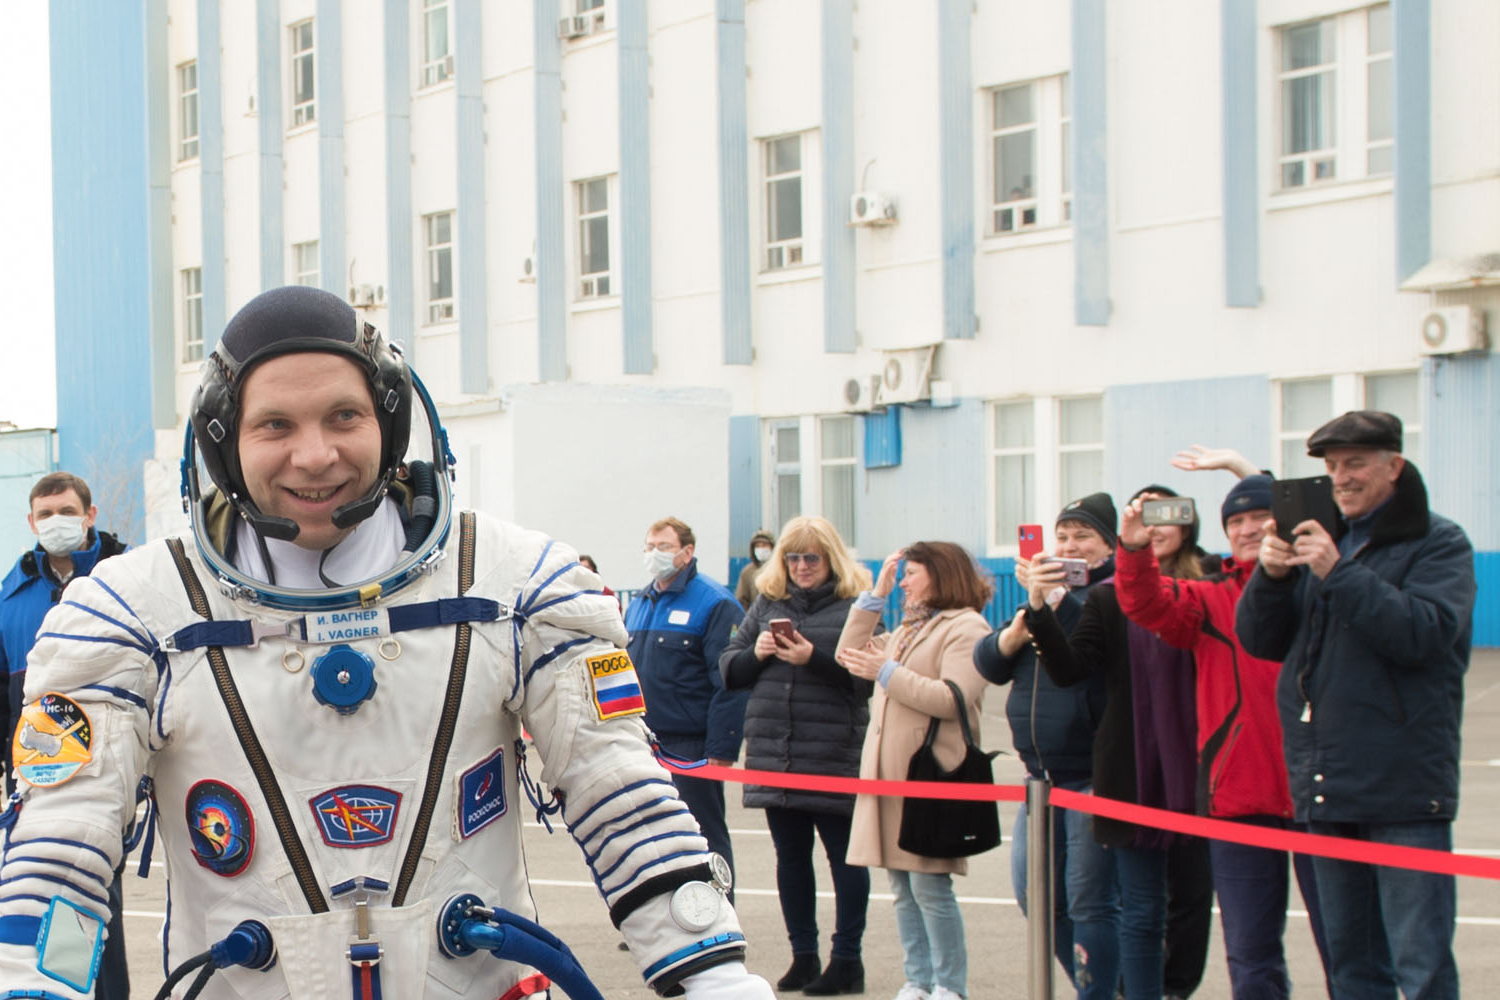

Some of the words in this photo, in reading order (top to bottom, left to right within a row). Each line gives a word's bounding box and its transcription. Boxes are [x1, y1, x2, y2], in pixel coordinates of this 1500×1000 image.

[317, 616, 328, 625] И.
[331, 610, 378, 624] ВАГНЕР
[318, 632, 325, 641] I.
[328, 626, 379, 640] VAGNER
[591, 655, 630, 675] РОСС
